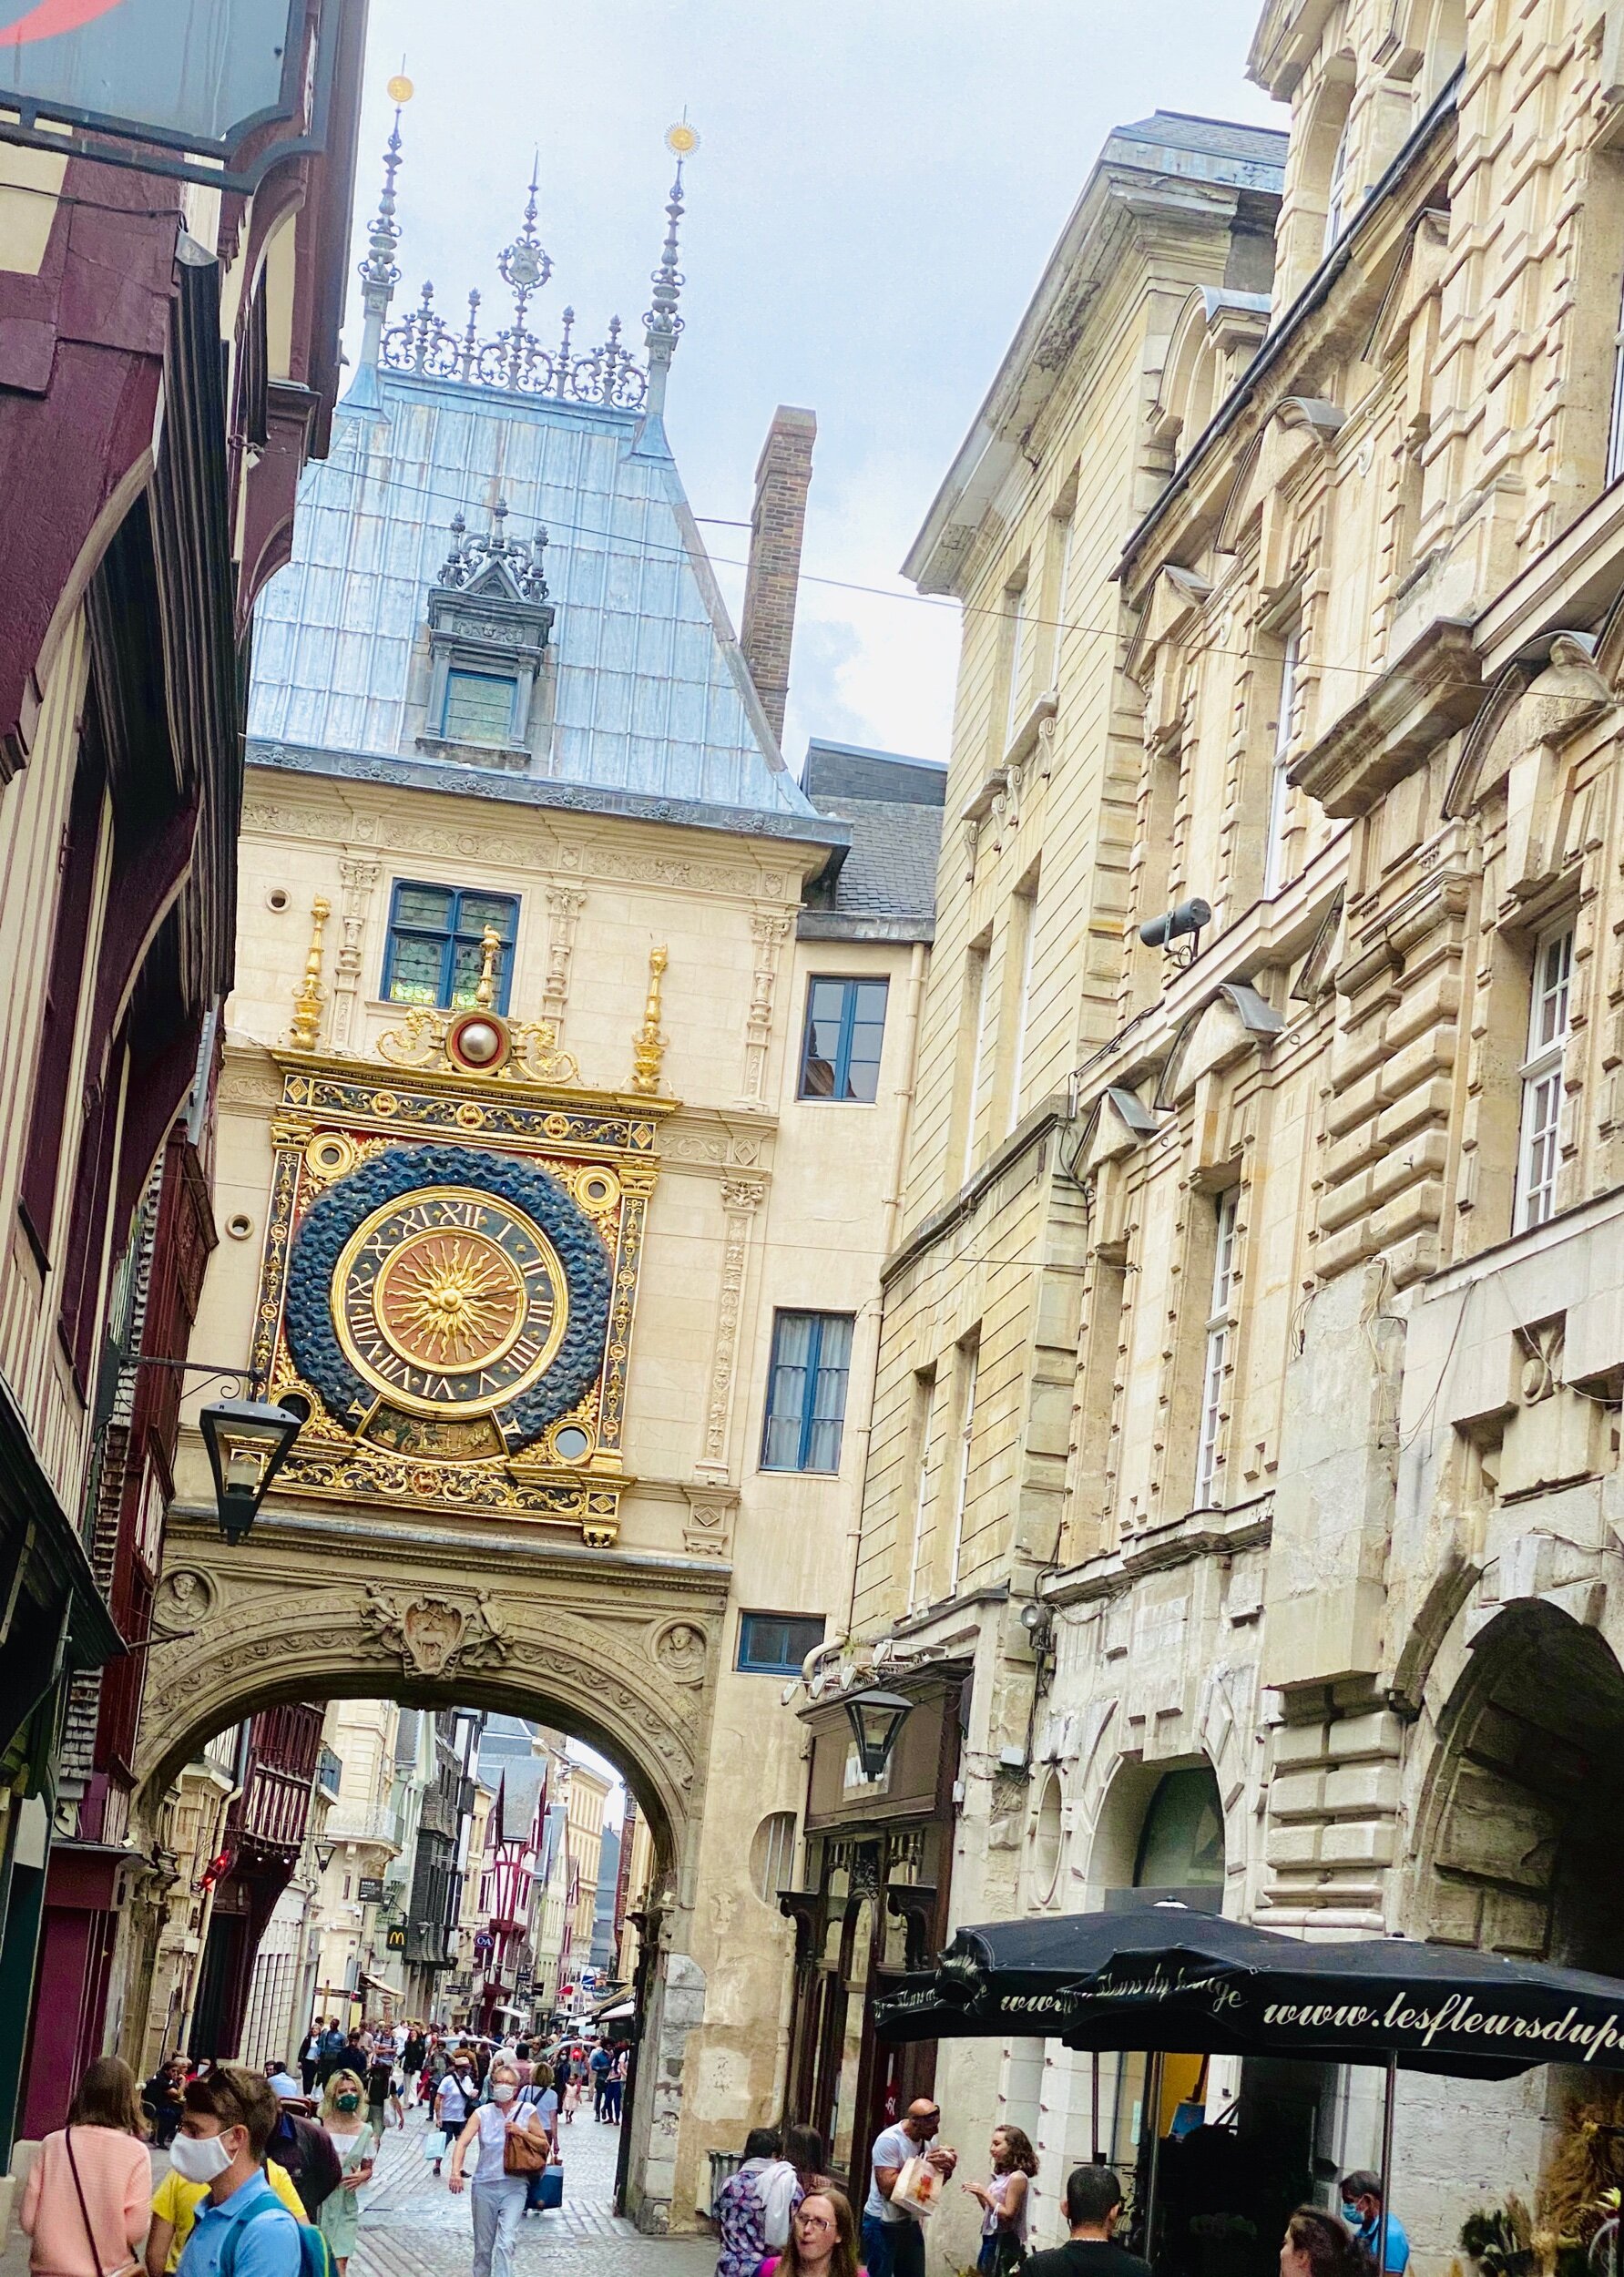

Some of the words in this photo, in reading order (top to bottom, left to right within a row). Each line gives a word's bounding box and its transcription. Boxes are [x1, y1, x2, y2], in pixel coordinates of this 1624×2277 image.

[395, 1205, 433, 1237] XI
[439, 1202, 482, 1230] XII
[495, 1221, 513, 1242] I
[363, 1232, 394, 1262] X
[521, 1258, 547, 1279] II
[349, 1273, 374, 1308] IX
[528, 1300, 554, 1327] III
[350, 1312, 380, 1360] VIII
[374, 1353, 412, 1391] VII
[477, 1371, 503, 1396] V
[422, 1374, 455, 1400] VI
